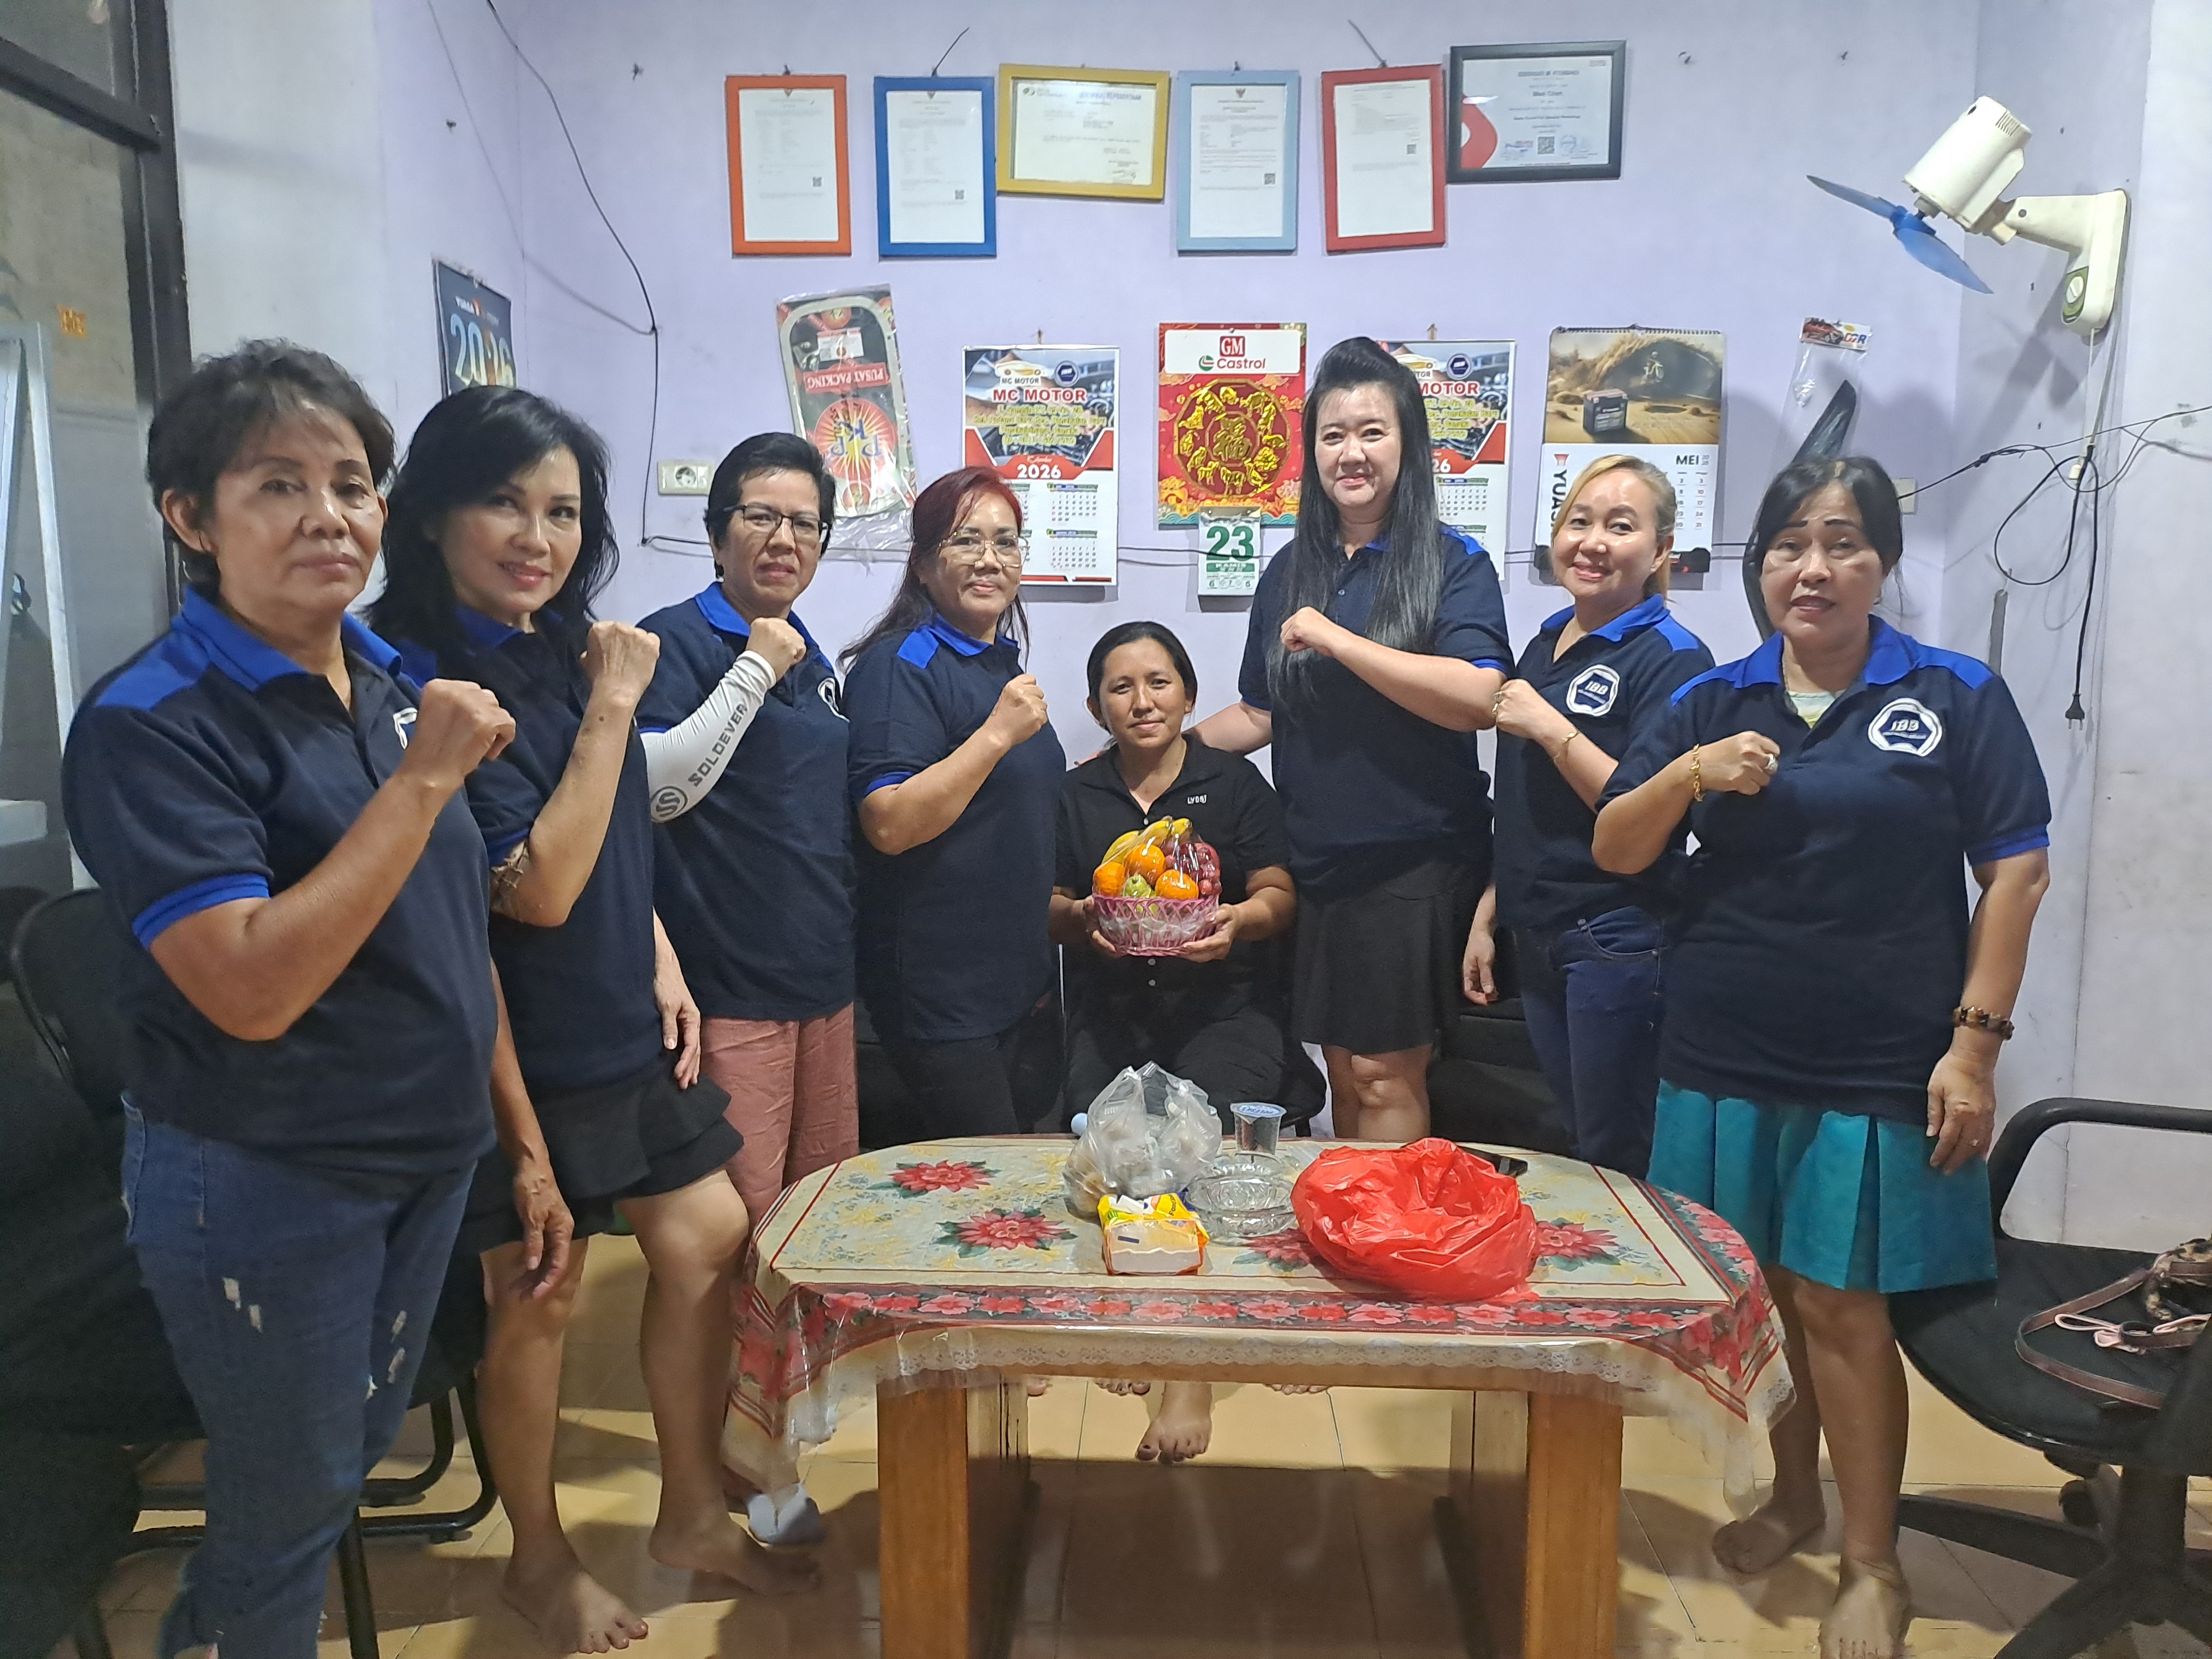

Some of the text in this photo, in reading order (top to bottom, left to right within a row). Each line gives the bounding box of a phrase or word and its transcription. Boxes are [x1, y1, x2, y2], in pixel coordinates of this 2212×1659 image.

[1221, 337, 1244, 355] GM
[1217, 358, 1266, 369] Castrol
[807, 367, 884, 389] PUSAT PACKING
[993, 389, 1087, 401] MC MOTOR
[1676, 455, 1699, 465] MEI
[1017, 464, 1061, 479] 2026
[1206, 525, 1254, 561] 23
